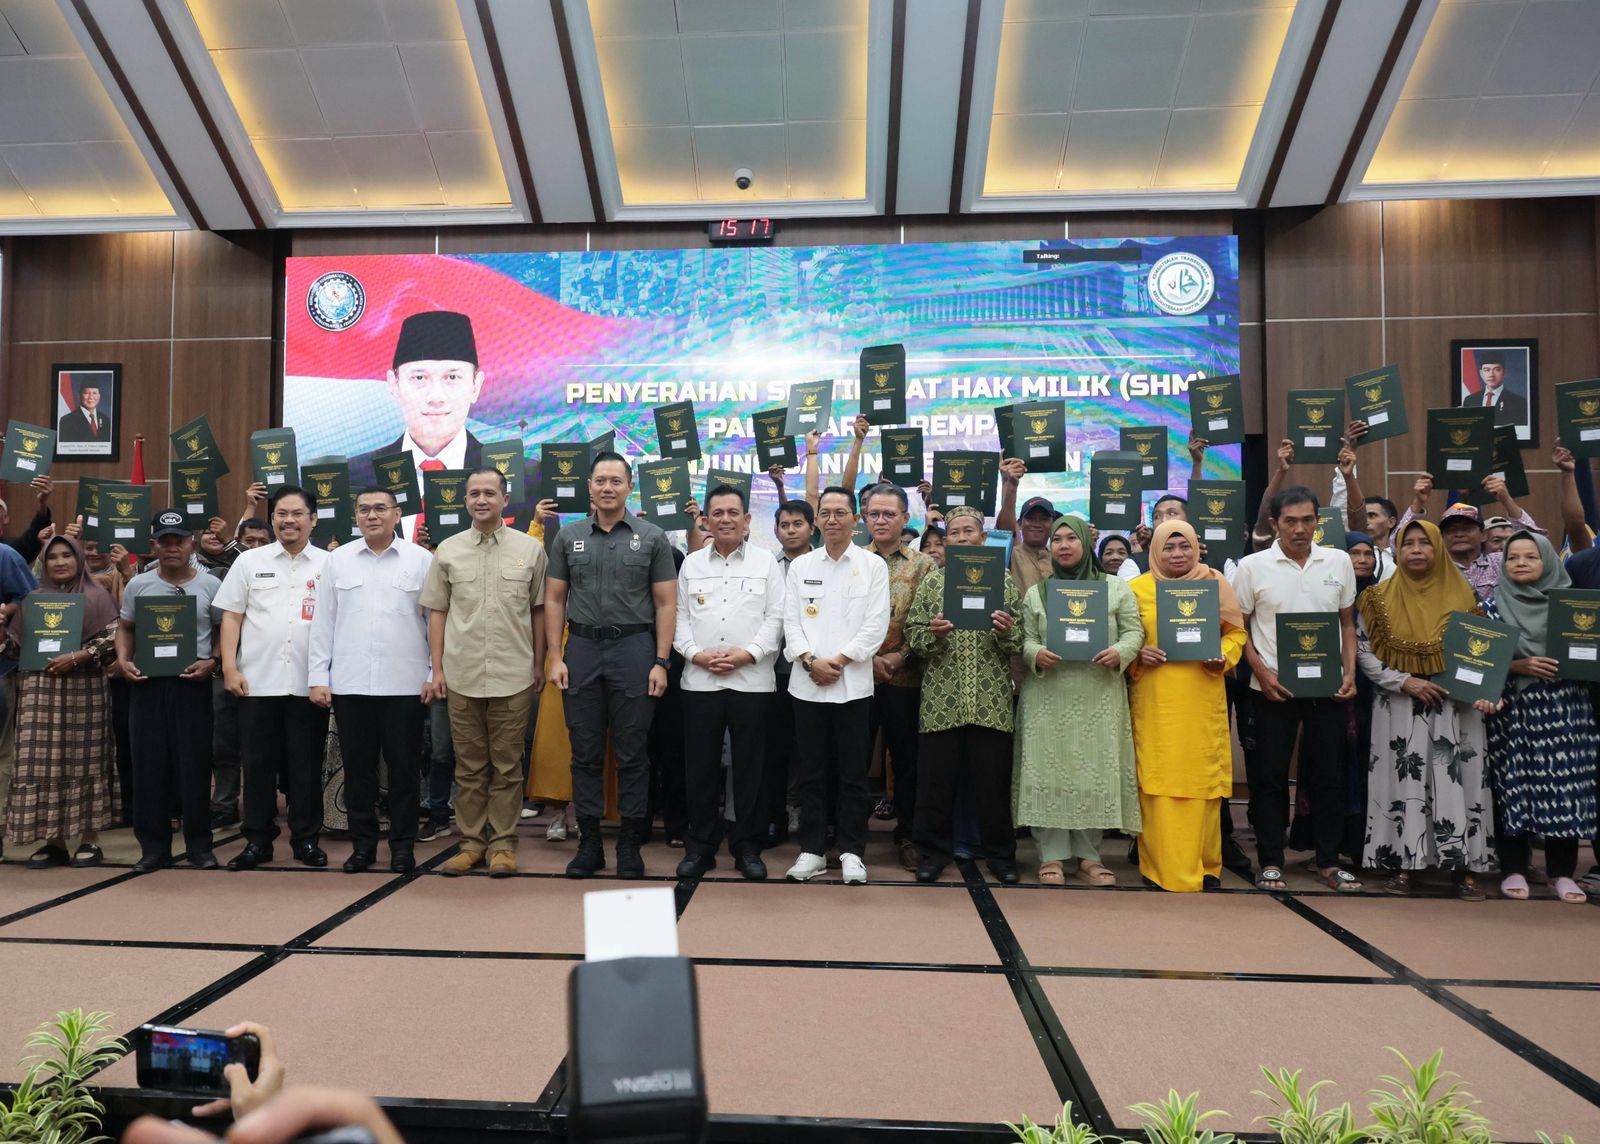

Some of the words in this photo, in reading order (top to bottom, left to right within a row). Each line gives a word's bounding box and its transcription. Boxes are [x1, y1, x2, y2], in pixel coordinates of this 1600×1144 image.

[720, 219, 737, 236] 15
[751, 218, 769, 235] 17
[566, 380, 757, 404] PENYERAHAN
[951, 376, 1013, 399] HAK
[1021, 375, 1111, 398] MILIK
